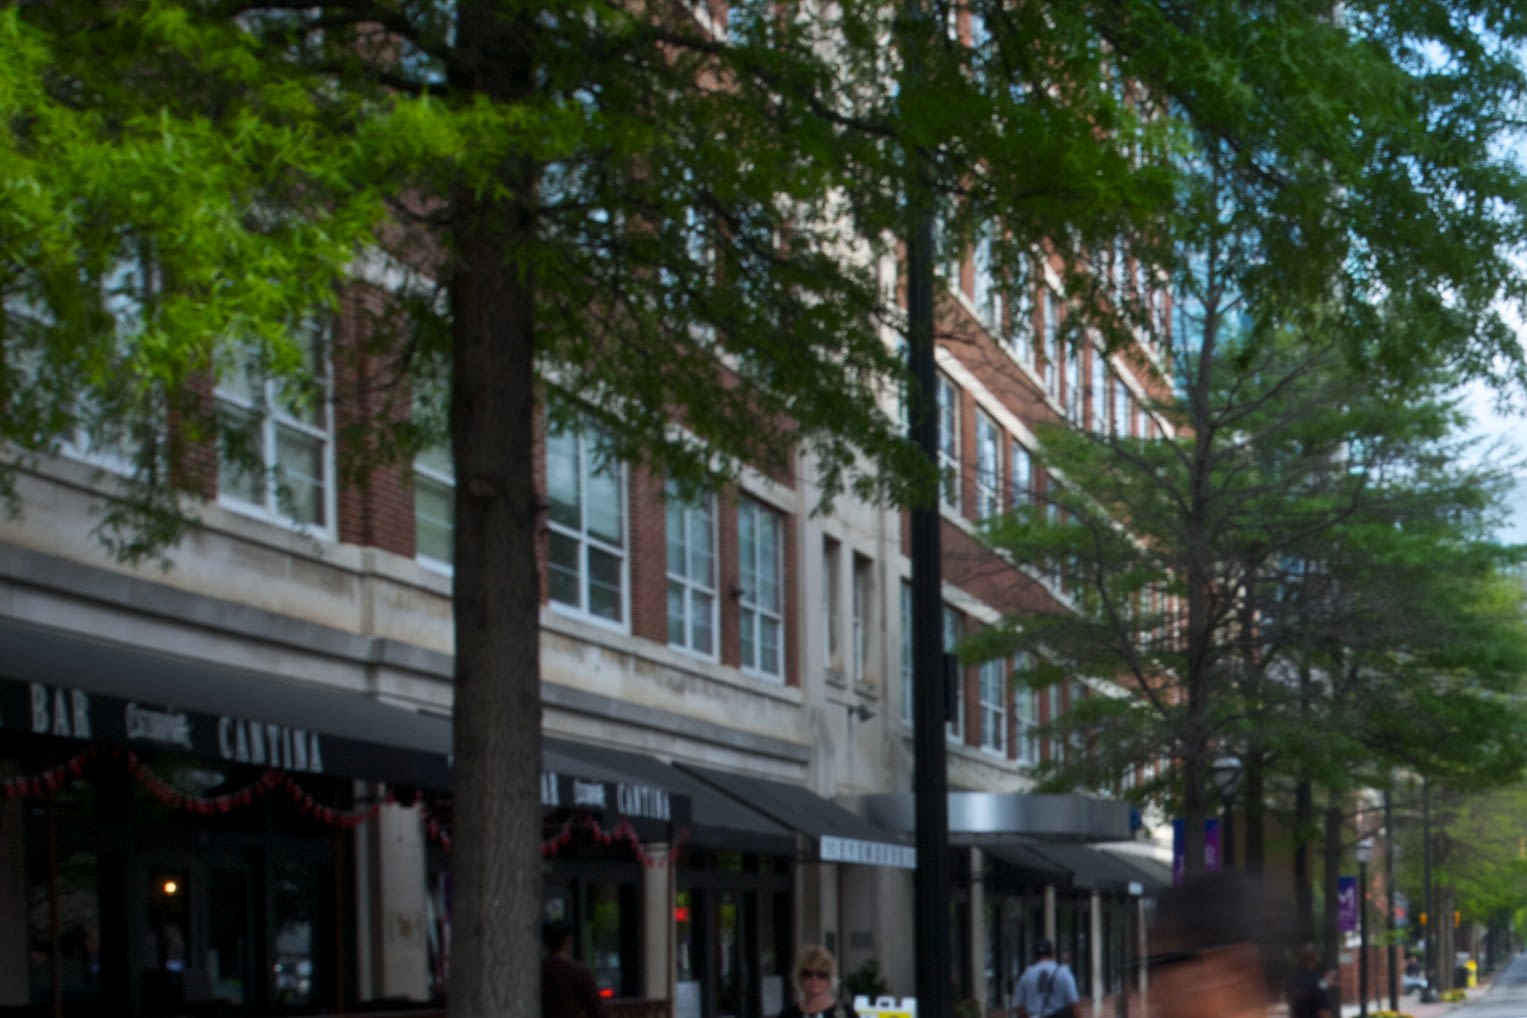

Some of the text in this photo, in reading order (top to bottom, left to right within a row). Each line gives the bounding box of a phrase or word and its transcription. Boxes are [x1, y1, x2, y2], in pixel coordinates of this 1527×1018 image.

[29, 682, 92, 739] BAR
[217, 715, 324, 774] CANTINA
[617, 782, 671, 821] CANTINA
